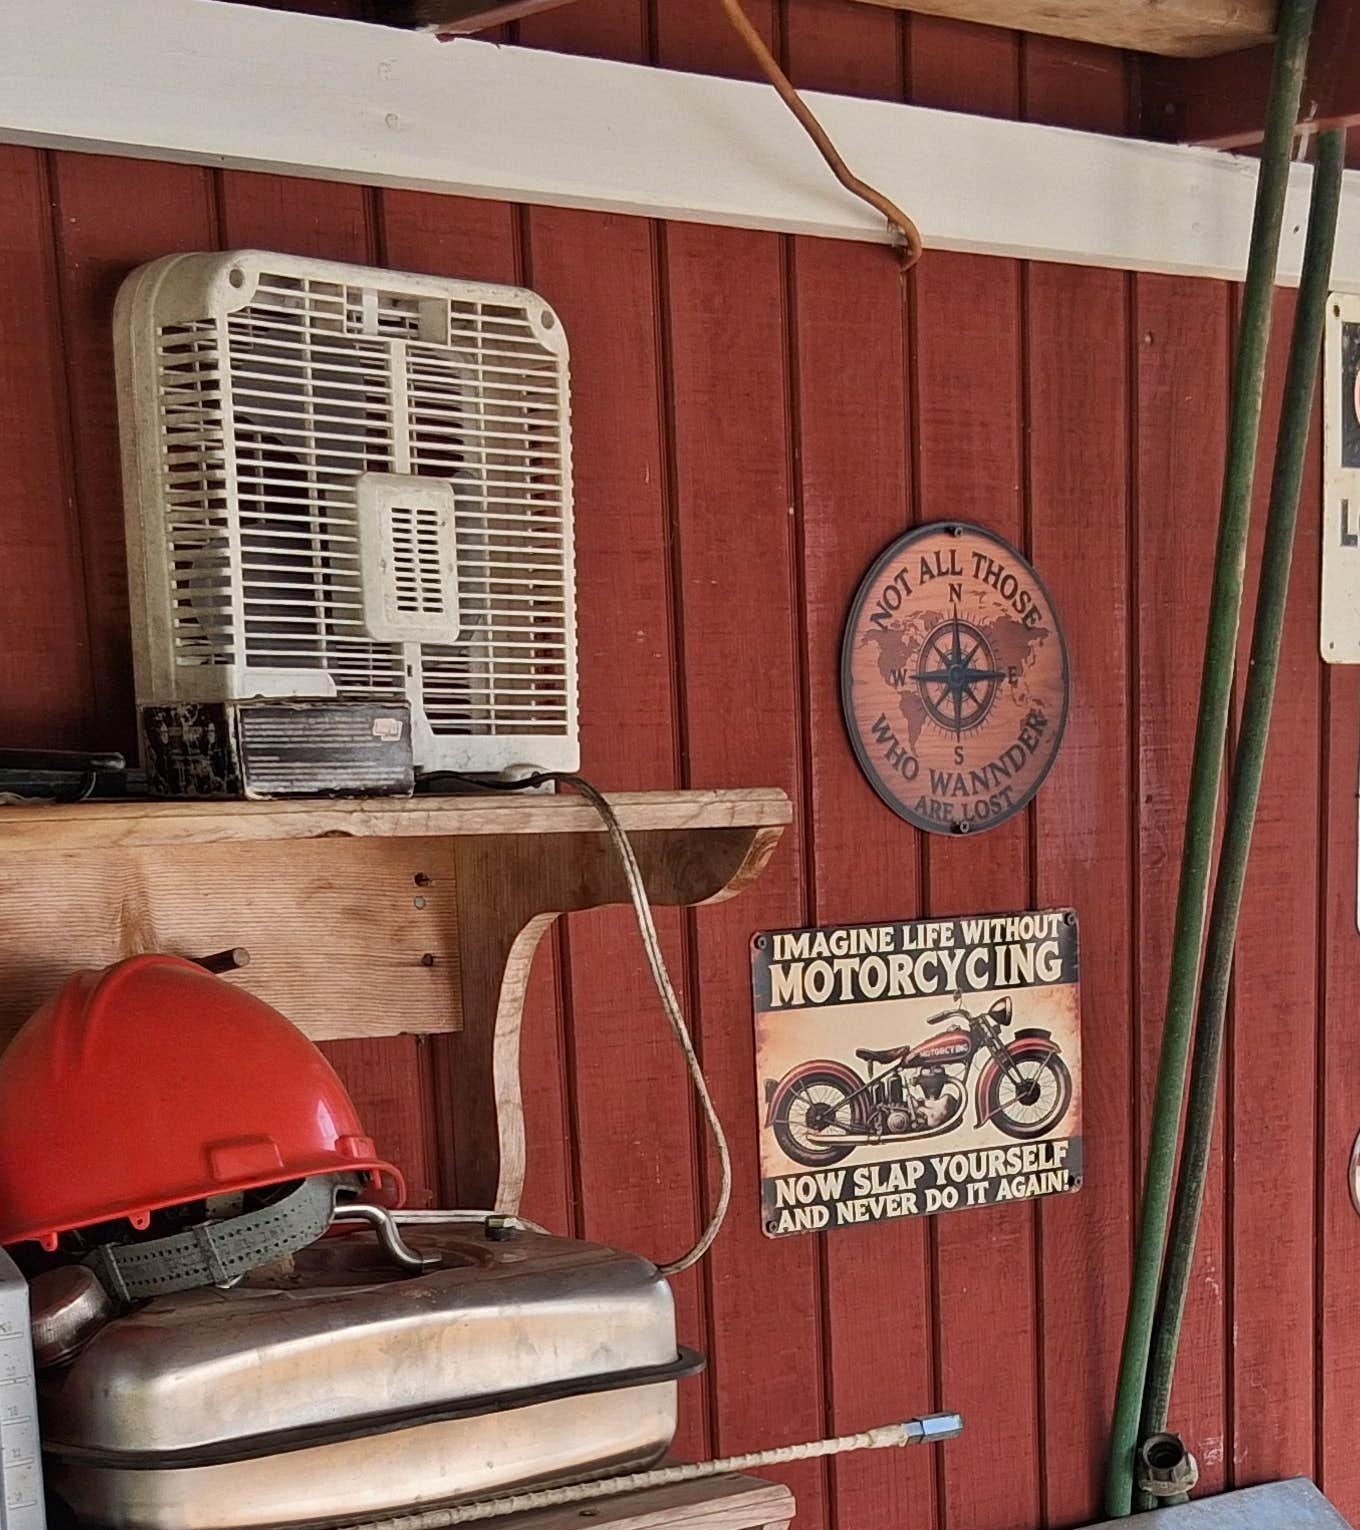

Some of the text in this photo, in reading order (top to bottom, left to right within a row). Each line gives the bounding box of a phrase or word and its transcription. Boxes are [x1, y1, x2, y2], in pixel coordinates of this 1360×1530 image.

[870, 549, 1042, 631] NOT ALL THOSE
[949, 583, 962, 603] N
[892, 666, 1017, 687] W E
[871, 713, 920, 782] WHO
[955, 746, 964, 765] S
[914, 785, 1016, 824] ARE LOST
[772, 913, 1063, 961] IMAGINE LIFE WITHOUT
[775, 1141, 1069, 1208] NOW SLAP YOURSELF
[775, 1170, 1070, 1233] AND NEVER DO IT AGAIN!
